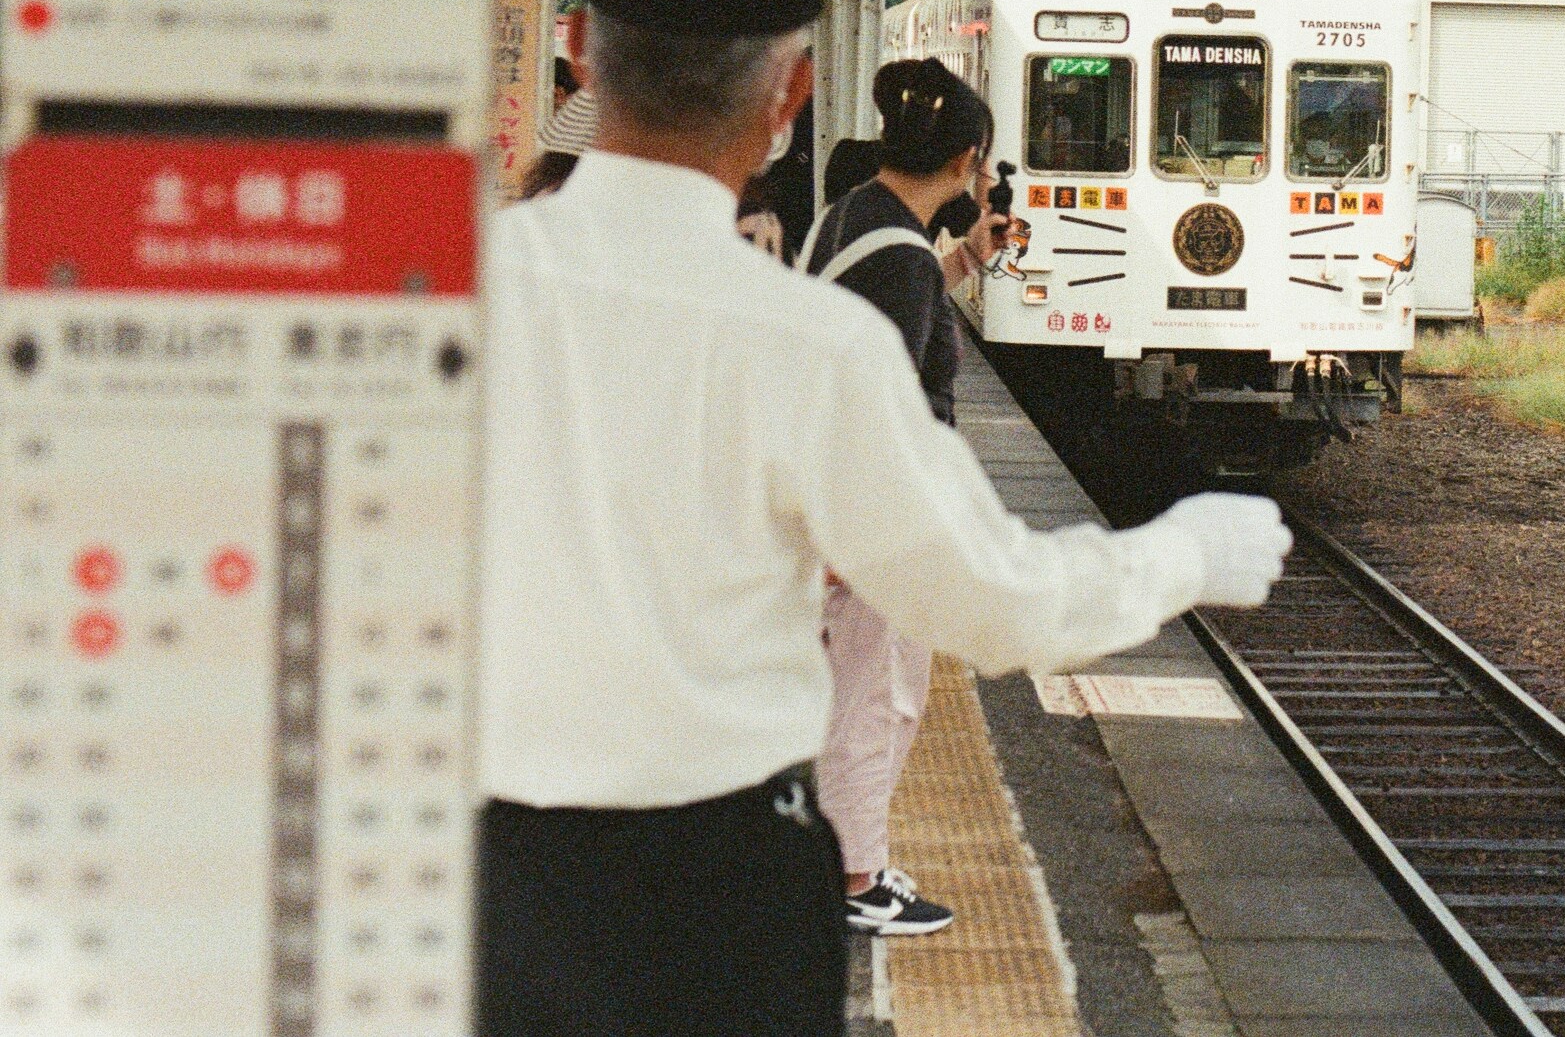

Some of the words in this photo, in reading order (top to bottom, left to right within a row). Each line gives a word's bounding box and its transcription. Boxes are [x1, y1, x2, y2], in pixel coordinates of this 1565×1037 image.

[1299, 20, 1382, 30] TAMADENSHA
[1316, 32, 1366, 48] 2705
[1165, 45, 1201, 63] TAMA
[1205, 47, 1262, 65] DENSHA
[1052, 58, 1109, 74] ワンマン
[1030, 188, 1125, 208] たま電車
[1293, 195, 1381, 212] TAMA
